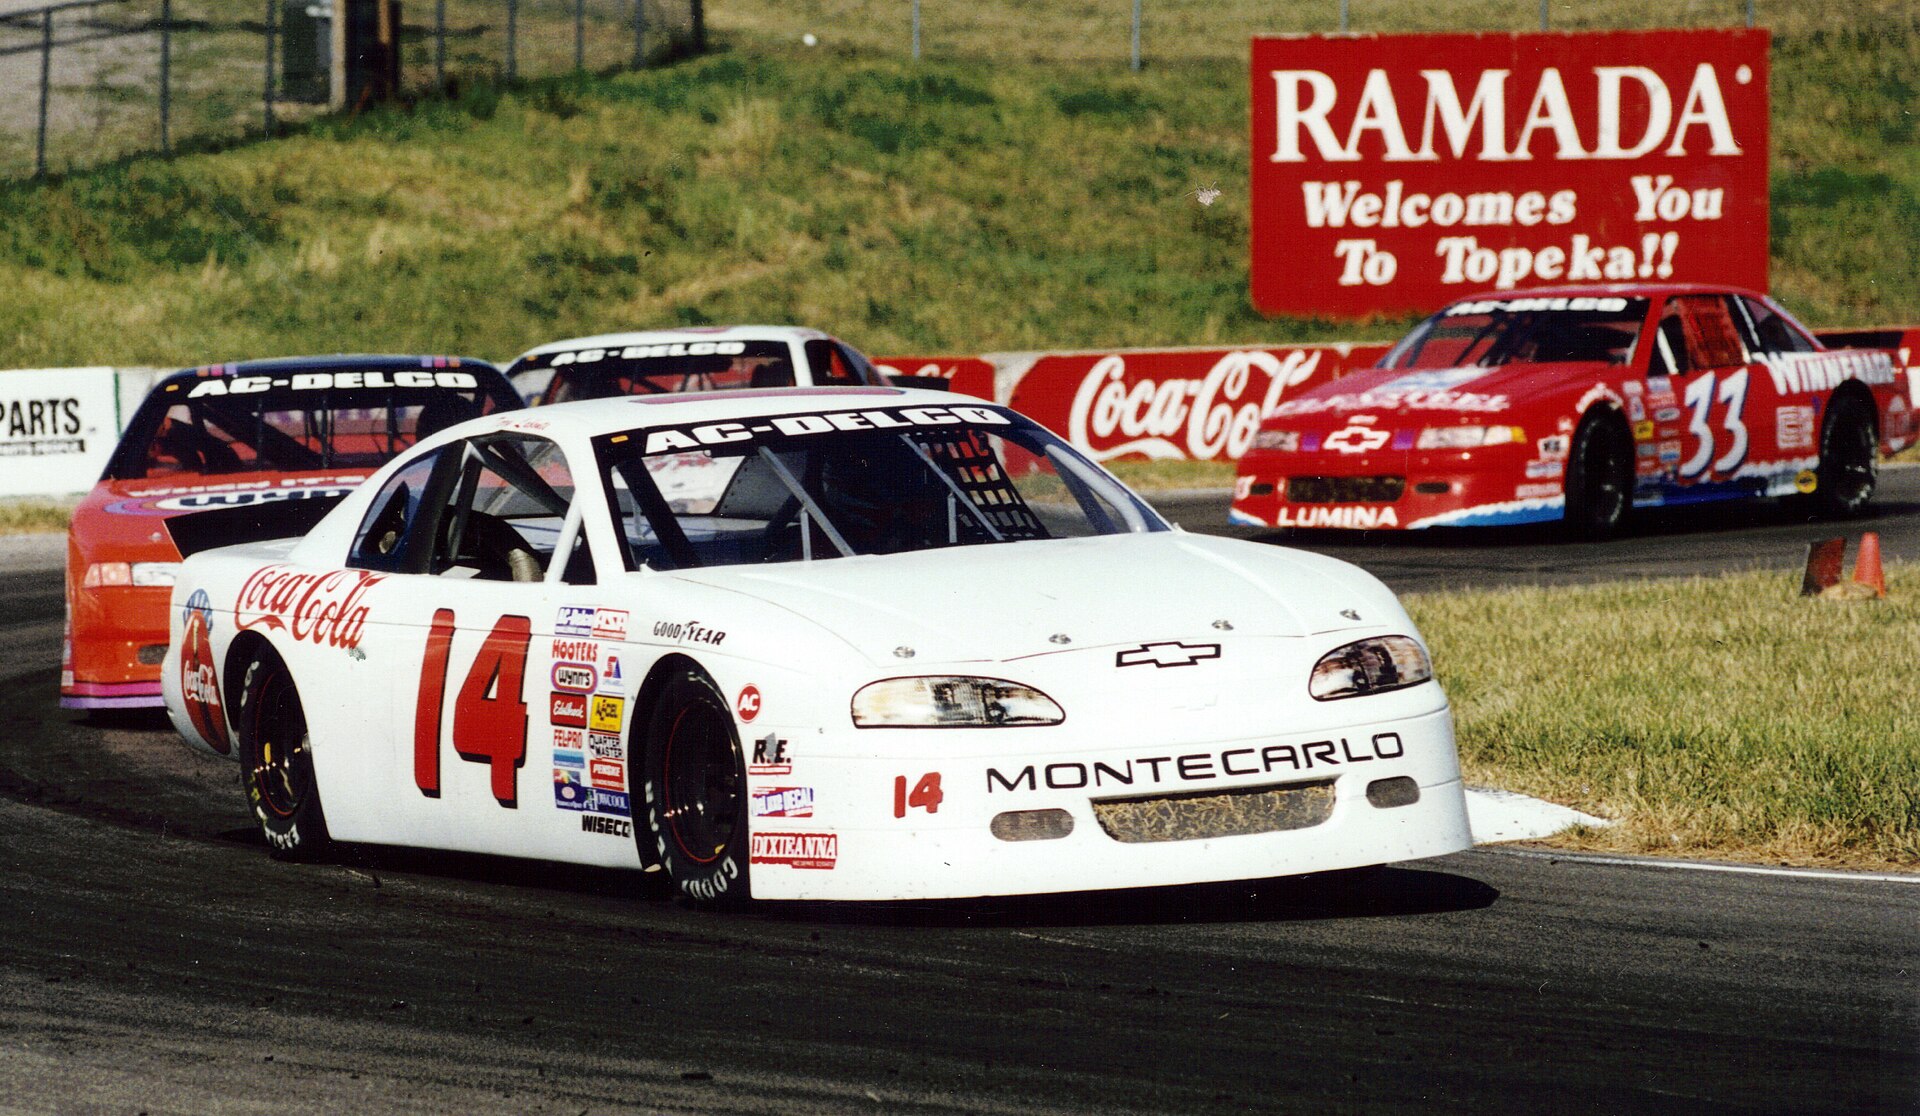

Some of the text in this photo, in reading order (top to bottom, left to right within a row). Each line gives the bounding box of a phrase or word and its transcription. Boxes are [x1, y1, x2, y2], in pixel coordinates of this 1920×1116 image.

[1270, 63, 1743, 163] RAMADA
[1301, 175, 1725, 229] Welcomes You
[1335, 233, 1680, 290] To Topeka!!
[188, 372, 478, 398] AC-DELCO
[1069, 351, 1322, 460] Coca-Col
[645, 407, 1012, 455] AC-DELCO
[1680, 367, 1750, 480] 33
[1277, 506, 1398, 528] LUMINA
[234, 564, 391, 650] Coca-Cola
[552, 639, 598, 662] HOOTERS
[413, 607, 532, 810] 14
[738, 693, 760, 712] AC
[986, 732, 1405, 794] MONTECARLO
[893, 771, 944, 818] 14
[753, 835, 837, 859] DIXIEANNA
